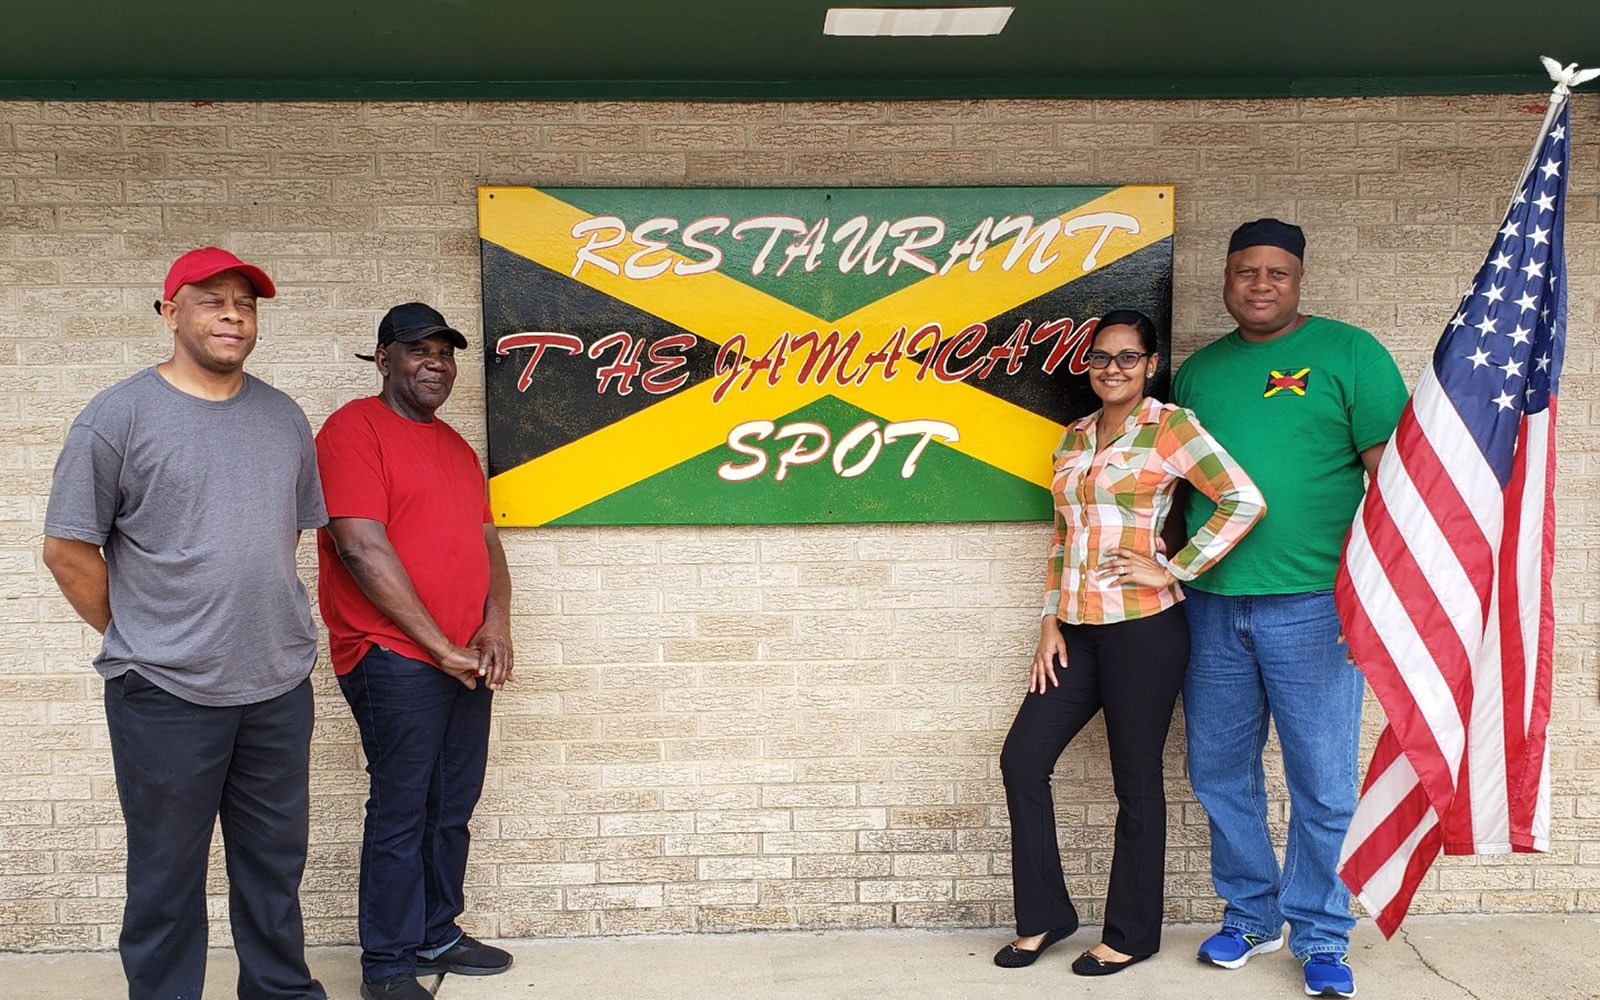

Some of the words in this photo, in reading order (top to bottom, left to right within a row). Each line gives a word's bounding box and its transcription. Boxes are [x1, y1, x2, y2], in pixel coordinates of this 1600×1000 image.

[571, 213, 1141, 280] RESTAURANT
[496, 331, 699, 396] THE
[712, 317, 1101, 404] JAMAICAN
[718, 419, 960, 482] SPOT
